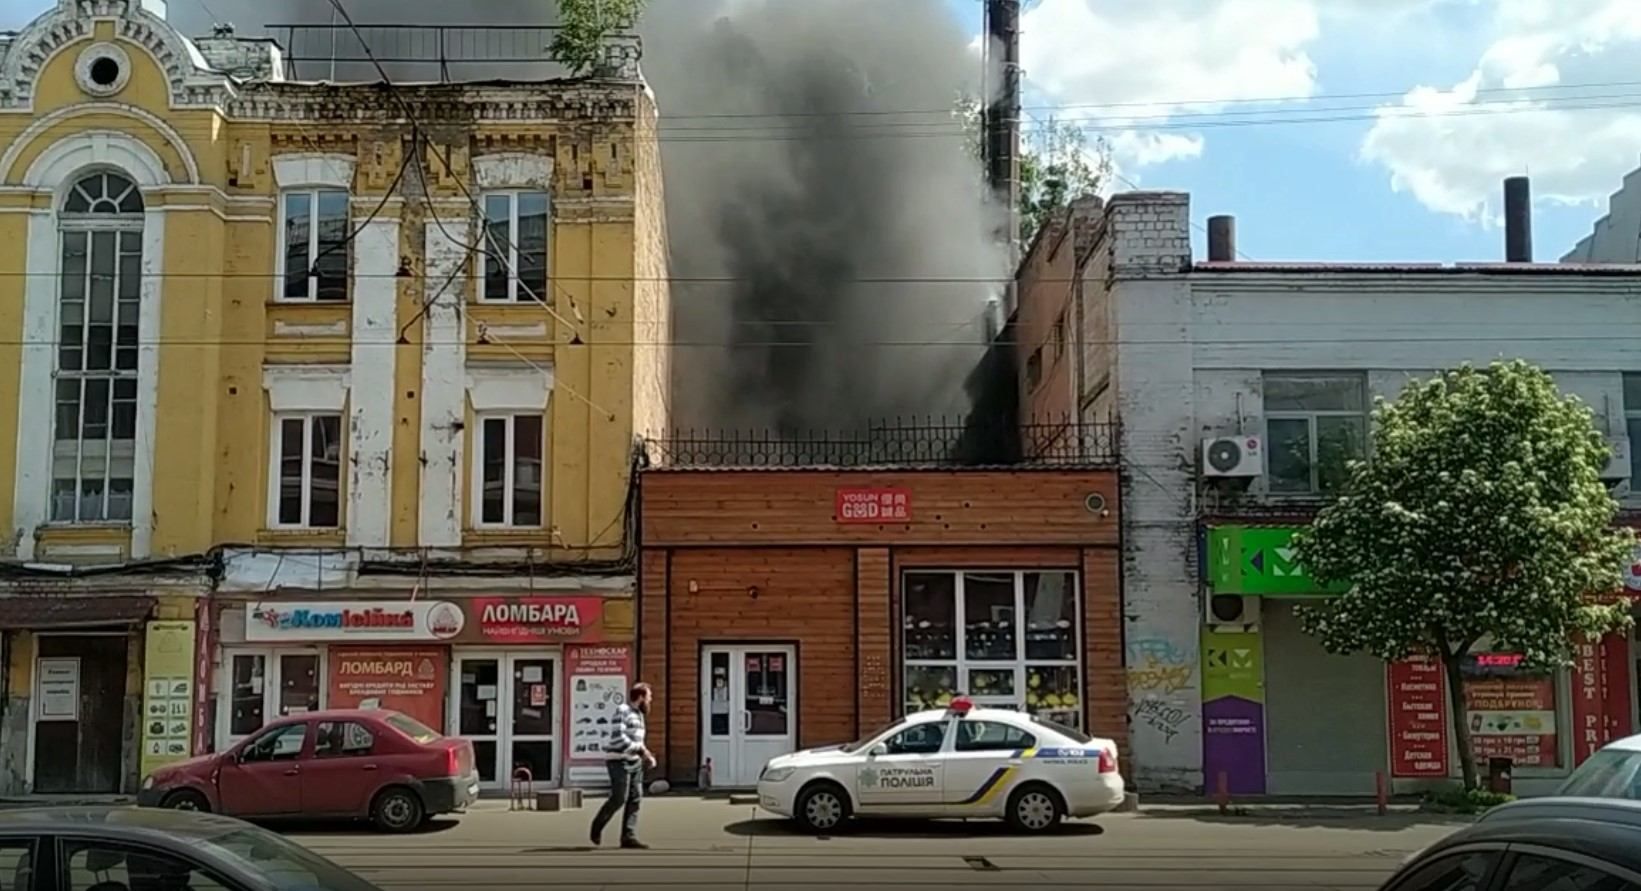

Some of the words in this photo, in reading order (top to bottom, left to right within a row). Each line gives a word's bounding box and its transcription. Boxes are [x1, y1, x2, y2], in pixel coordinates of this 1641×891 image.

[842, 493, 878, 502] YOSUN
[482, 603, 580, 626] ЛОМБАРД
[339, 661, 414, 678] ЛОМБАРД
[1582, 644, 1598, 700] BEST
[1585, 715, 1599, 755] PRI
[880, 768, 933, 776] ПАТРУЛЬНА
[880, 776, 935, 788] ПОЛІЦІЯ
